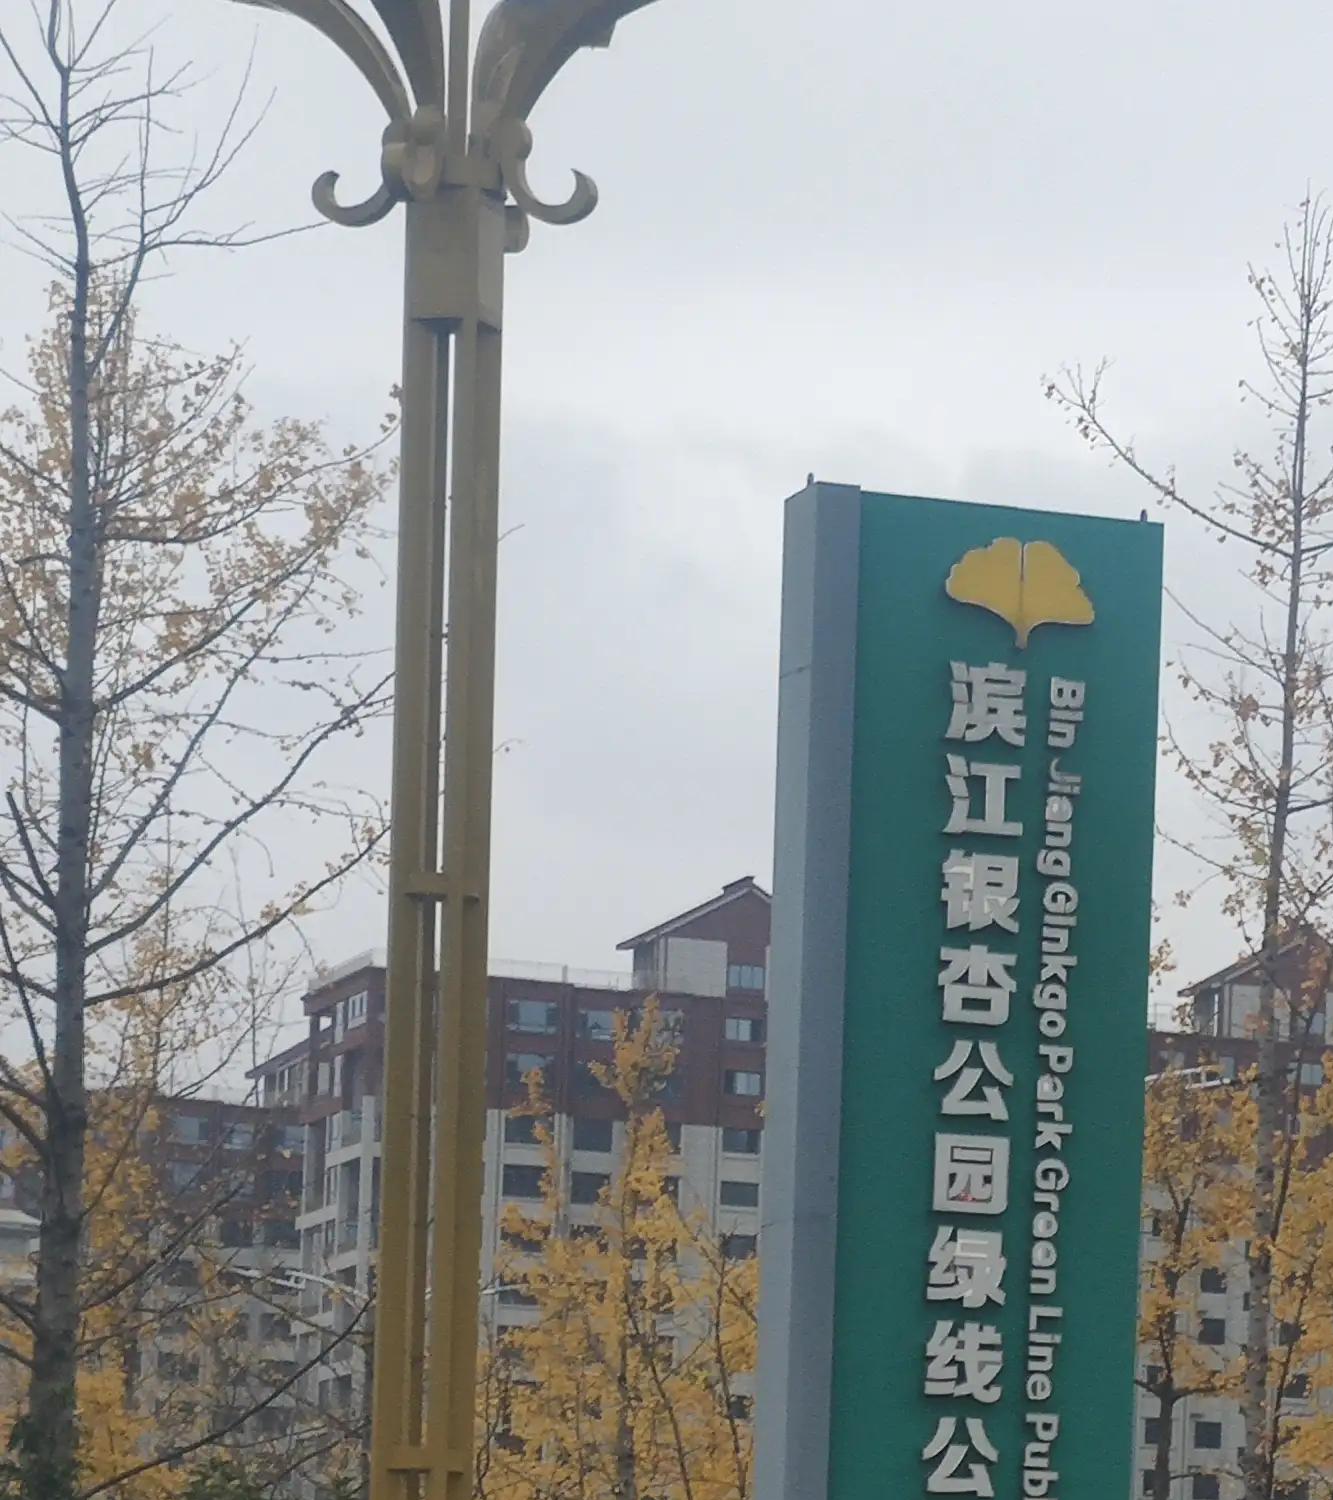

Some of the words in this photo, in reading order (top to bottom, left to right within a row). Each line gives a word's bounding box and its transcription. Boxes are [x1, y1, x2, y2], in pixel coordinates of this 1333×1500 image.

[1048, 676, 1086, 748] Bin
[1036, 758, 1081, 877] Jiang
[1033, 881, 1079, 1038] Ginkgo
[1035, 1046, 1074, 1150] Park
[1030, 1159, 1070, 1295] Green
[1026, 1307, 1063, 1401] Line
